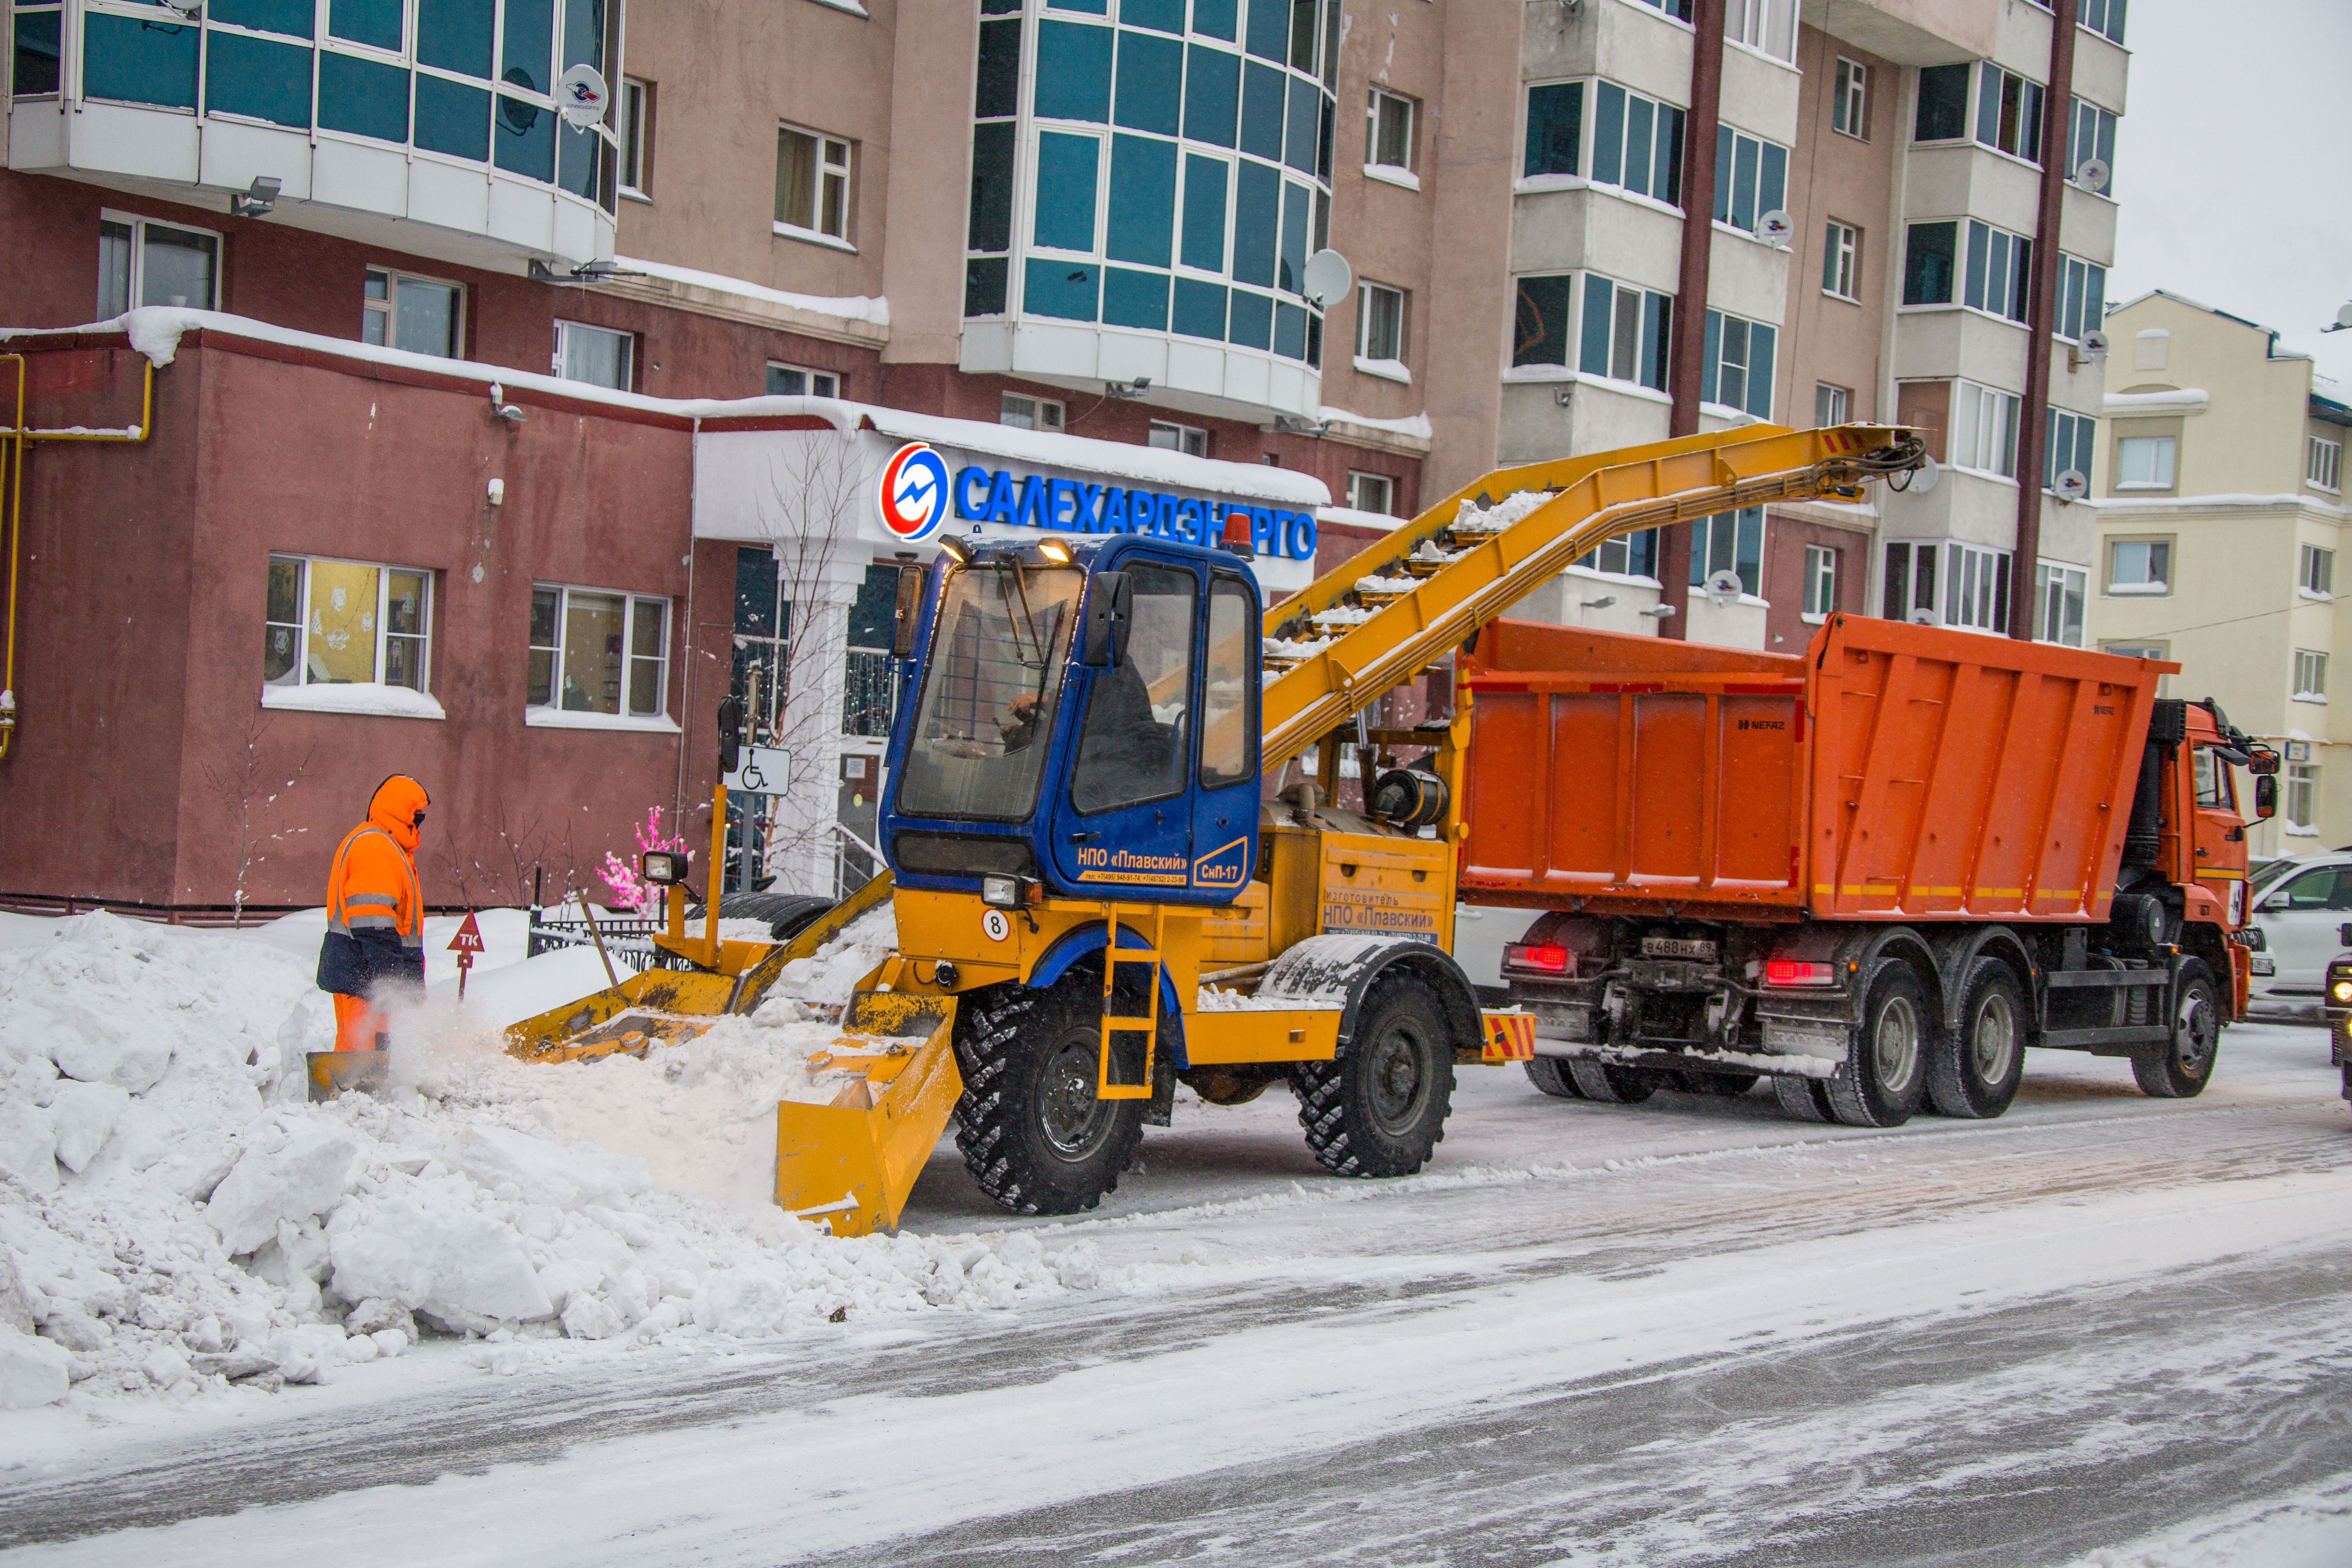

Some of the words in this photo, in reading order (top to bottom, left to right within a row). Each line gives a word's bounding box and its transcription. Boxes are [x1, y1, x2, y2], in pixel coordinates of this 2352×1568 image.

[1752, 721, 1785, 730] NEFAZ
[1078, 847, 1107, 866] НПО
[1111, 850, 1187, 870] «Плавский»
[1202, 864, 1238, 879] СнП-17
[1326, 891, 1398, 906] изготовитель
[1323, 905, 1353, 924] НПО
[1357, 906, 1433, 928] «Плавский»
[991, 916, 1001, 934] 8
[459, 933, 479, 946] ТК
